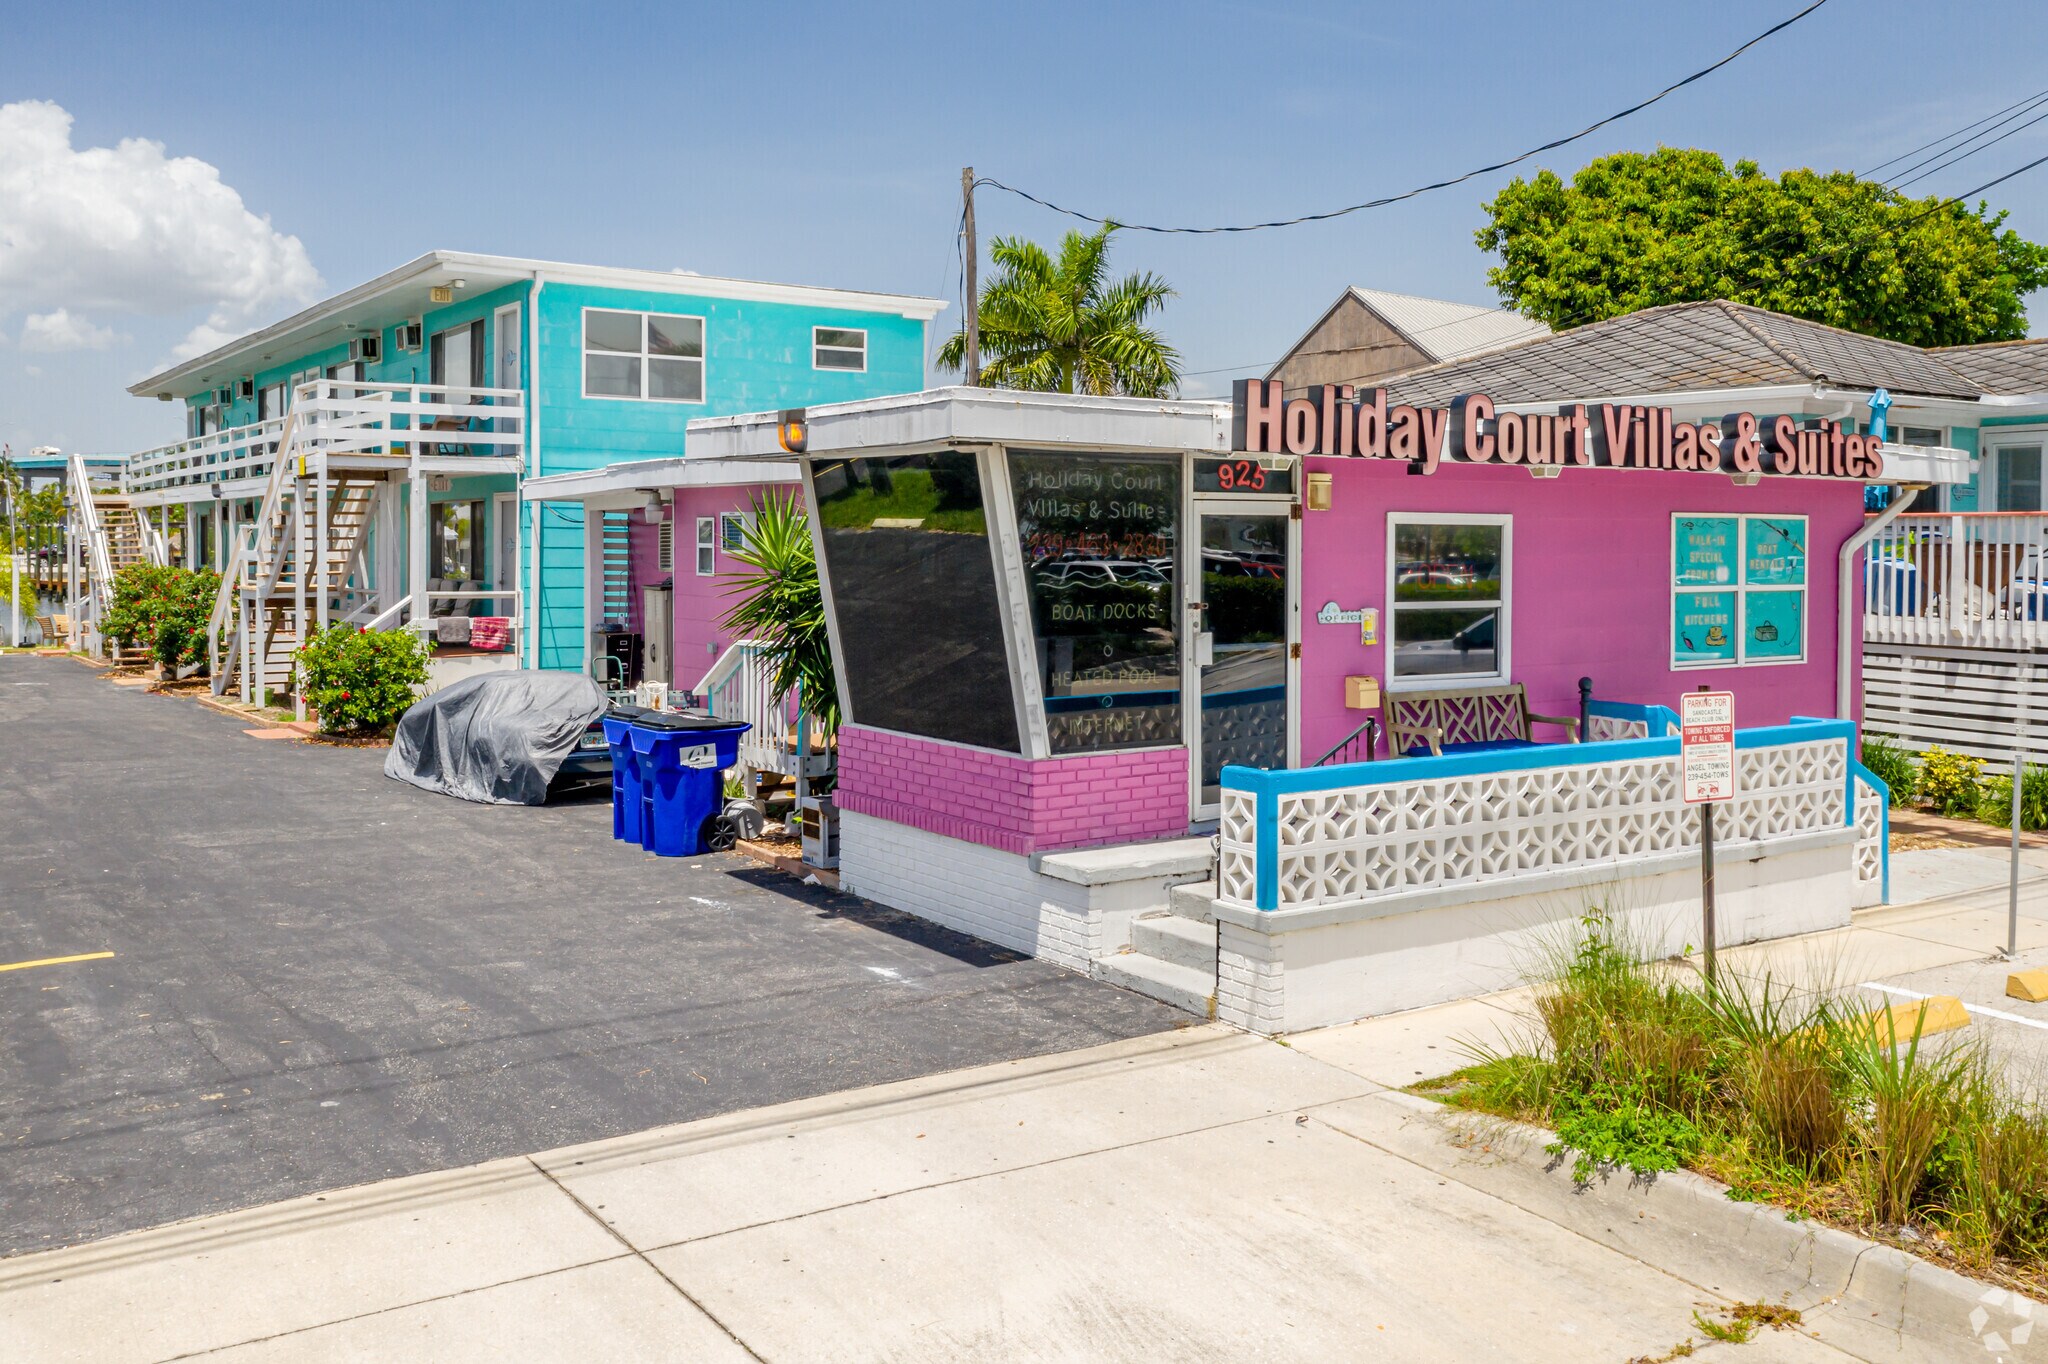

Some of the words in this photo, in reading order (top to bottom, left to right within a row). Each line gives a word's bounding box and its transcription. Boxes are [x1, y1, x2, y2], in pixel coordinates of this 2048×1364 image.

[434, 289, 450, 302] EXIT
[1239, 379, 1448, 475] Holiday
[1455, 393, 1589, 464] Court
[1597, 403, 1721, 471] Villas
[1729, 411, 1761, 473] &
[1770, 414, 1883, 478] Suites
[1028, 471, 1103, 491] Holiday
[1110, 472, 1162, 491] Court
[1217, 460, 1268, 490] 925
[1028, 498, 1081, 519] Villas
[1088, 500, 1103, 519] &
[1108, 501, 1167, 519] Suites
[1688, 535, 1726, 547] WALK-IN
[1757, 544, 1777, 555] BOAT
[1689, 551, 1723, 563] SPECIAL
[1750, 559, 1785, 570] RENTALS
[1416, 562, 1473, 591] OPEN
[1694, 596, 1720, 608] FULL
[1052, 604, 1095, 621] BOAT
[1103, 603, 1156, 619] DOCKS
[1684, 614, 1728, 626] KITCHENS
[1052, 670, 1113, 688] HEATED
[1118, 668, 1160, 685] POOL
[1687, 699, 1712, 708] PARKING
[1714, 698, 1727, 707] FOR
[1069, 715, 1142, 736] INTERNET
[1685, 727, 1703, 735] TOWING
[1704, 725, 1731, 733] ENFORCED
[1691, 735, 1698, 743] AT
[1709, 734, 1725, 742] TIMES
[1707, 762, 1729, 770] TOWING
[1688, 772, 1729, 781] 239-454-TOWS
